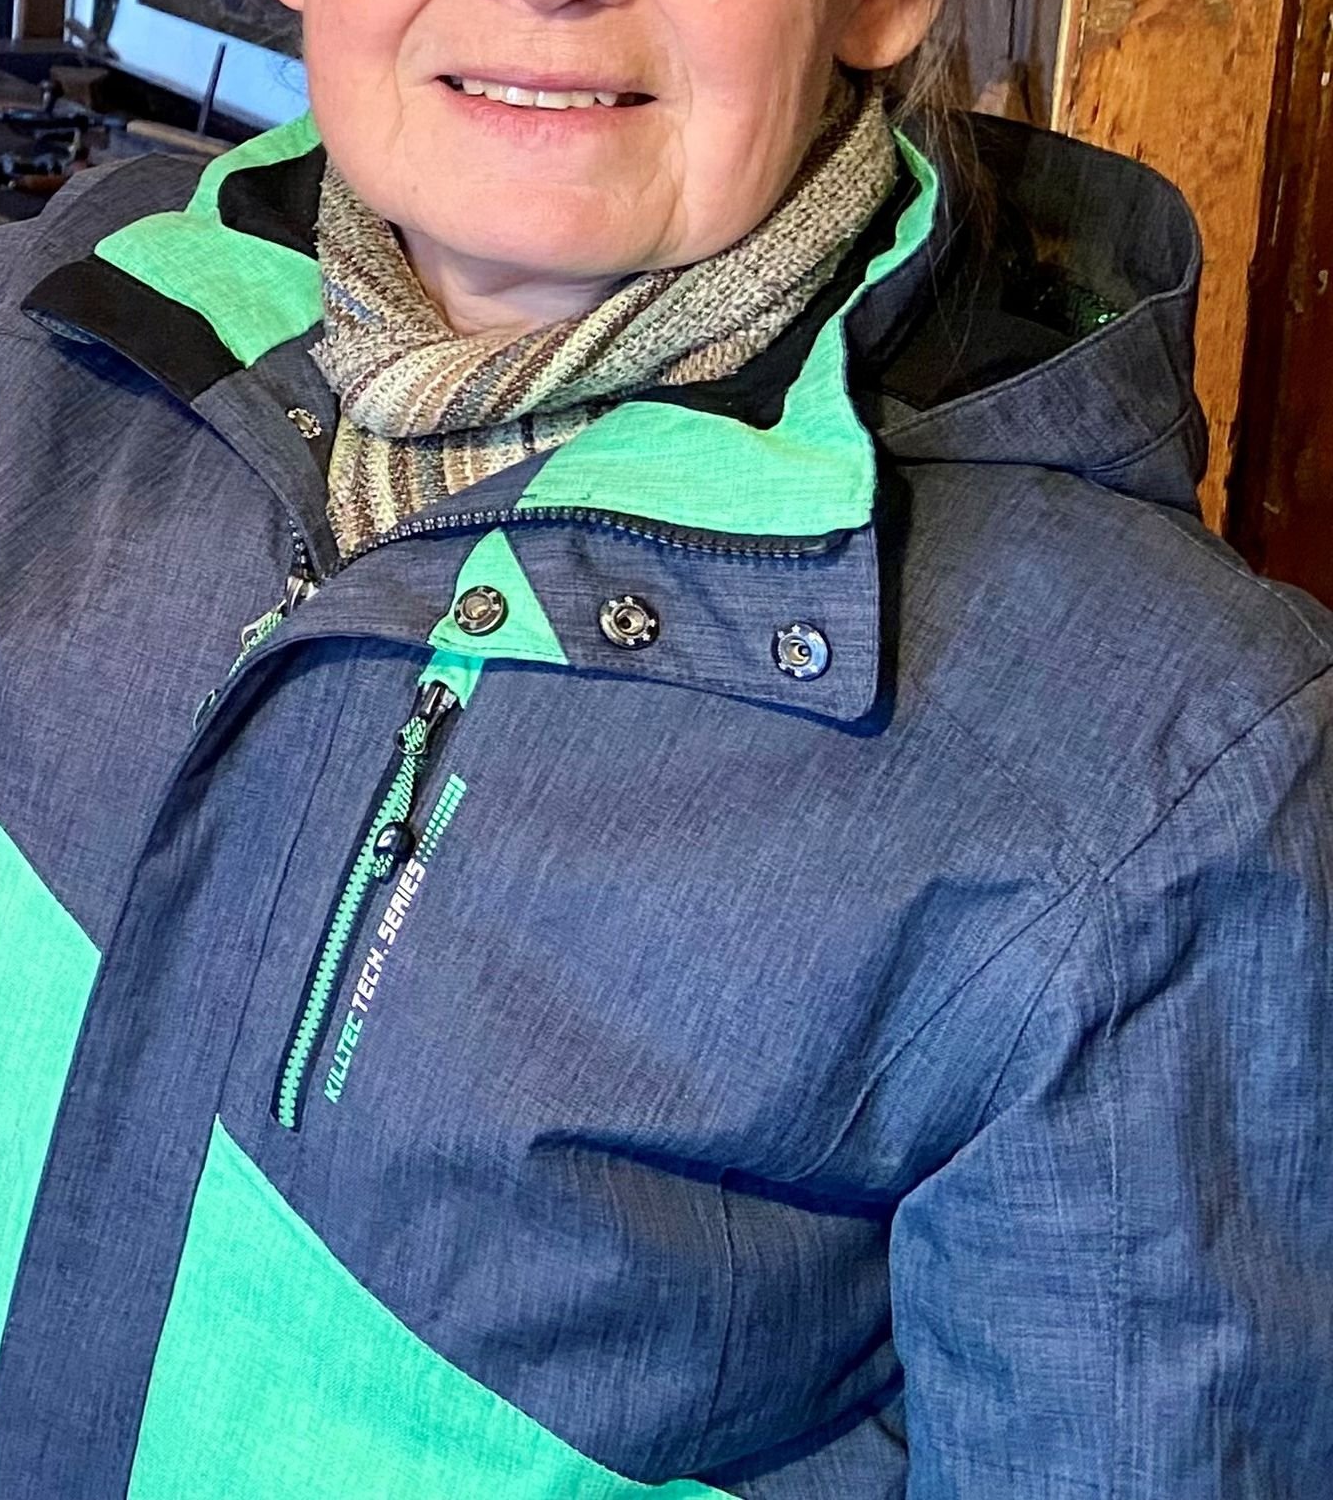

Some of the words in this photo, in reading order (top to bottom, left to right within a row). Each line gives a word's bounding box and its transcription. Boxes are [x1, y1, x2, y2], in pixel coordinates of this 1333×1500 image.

[324, 1010, 364, 1104] KILLTEC
[350, 946, 389, 1013] TECH.
[377, 858, 427, 945] SERIES
